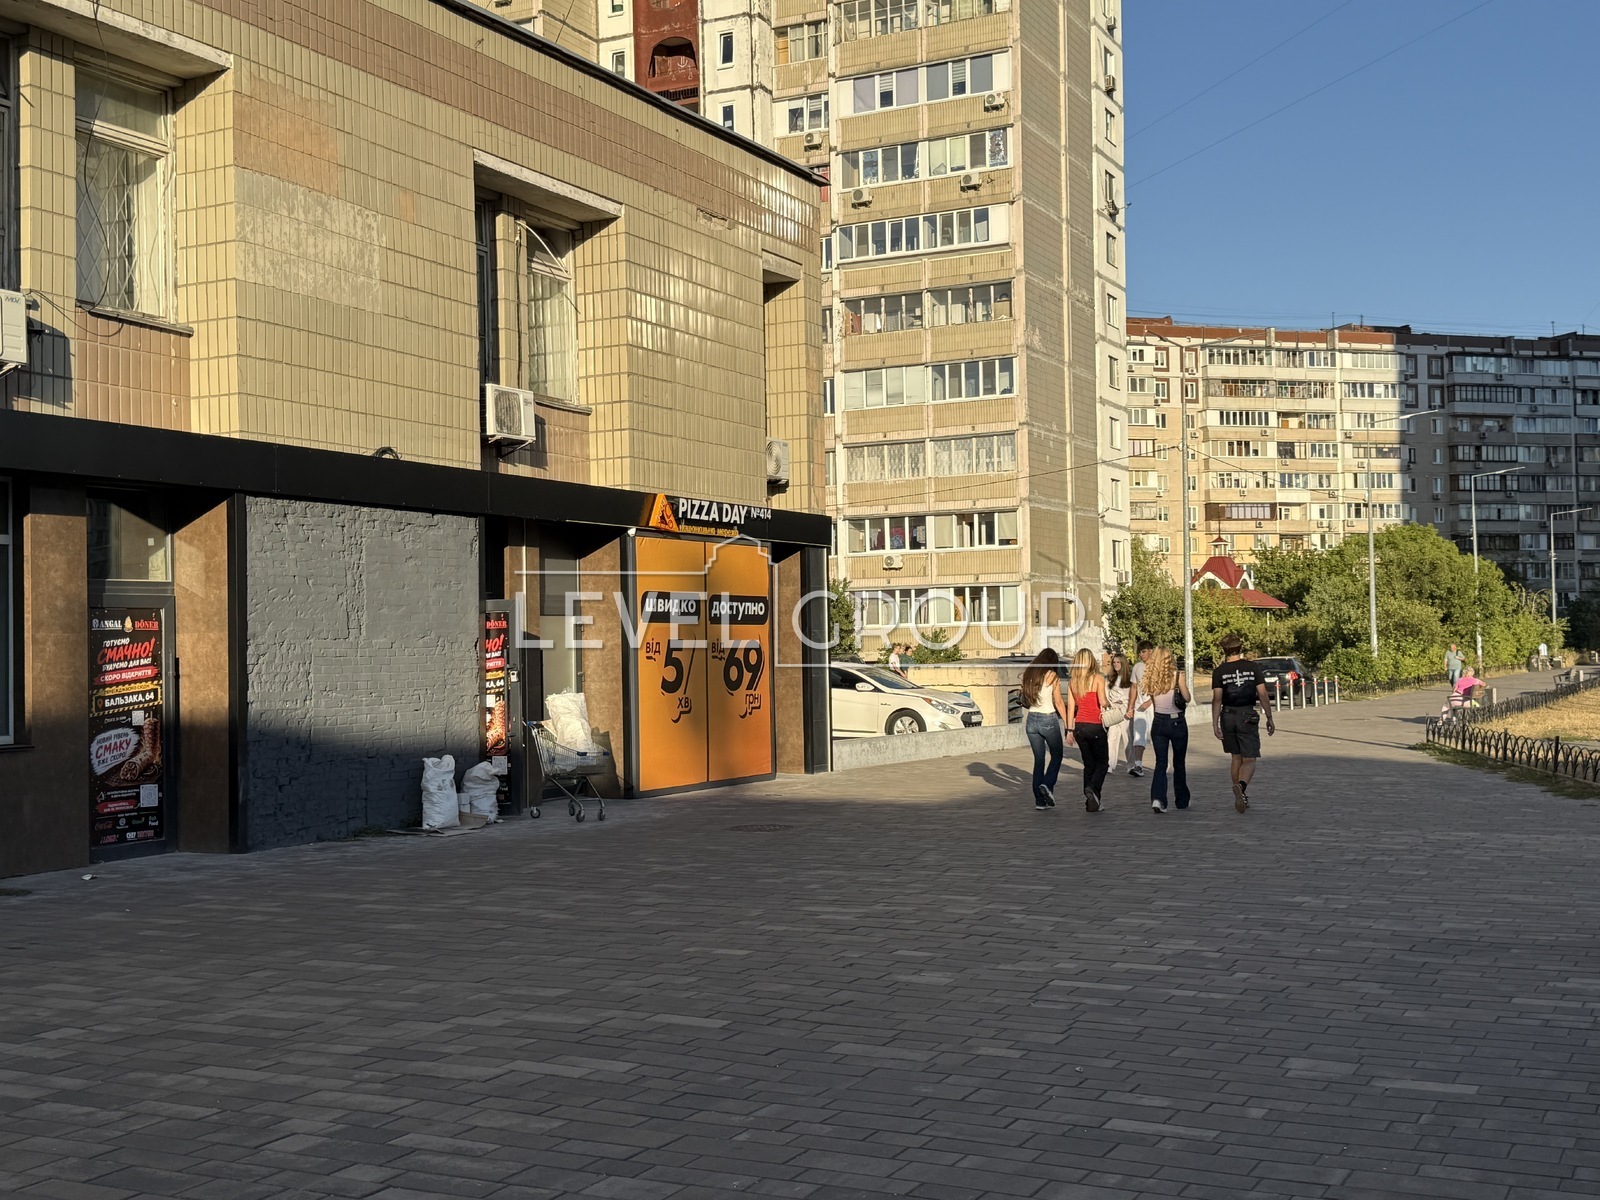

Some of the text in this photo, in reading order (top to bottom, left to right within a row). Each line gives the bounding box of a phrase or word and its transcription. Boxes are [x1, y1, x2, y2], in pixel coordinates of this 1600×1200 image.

[679, 498, 719, 522] PIZZA
[722, 503, 748, 525] DAY
[97, 636, 156, 665] СМАЧНО!
[100, 673, 121, 682] СКОРО
[645, 637, 684, 694] від 5
[711, 638, 763, 691] від 69
[105, 692, 154, 707] БАЛЬЗАКА, 64
[96, 739, 131, 759] СМАКУ
